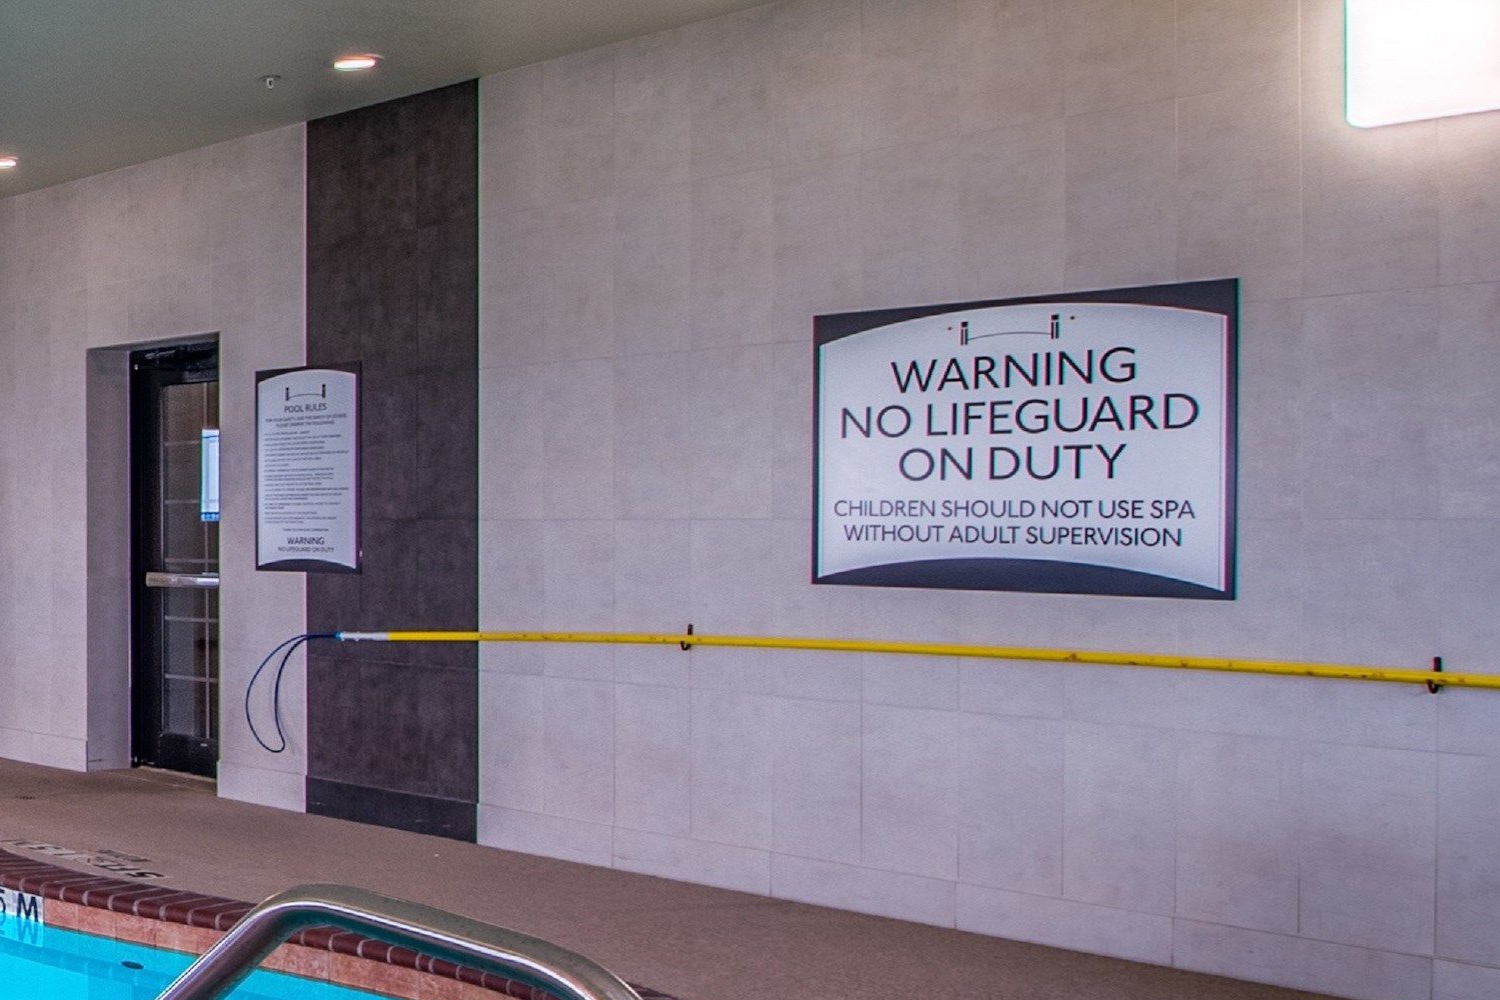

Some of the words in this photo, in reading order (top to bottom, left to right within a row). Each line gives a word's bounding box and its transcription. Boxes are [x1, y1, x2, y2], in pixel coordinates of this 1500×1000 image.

[891, 347, 1137, 394] WARNING
[284, 405, 304, 413] POOL
[305, 402, 328, 412] RULES
[841, 405, 912, 439] NO
[926, 393, 1199, 436] LIFEGUARD
[899, 447, 972, 482] ON
[989, 443, 1127, 480] DUTY
[833, 500, 936, 518] CHILDREN
[941, 499, 1035, 518] SHOULD
[1041, 500, 1093, 519] NOT
[1099, 500, 1143, 519] USE
[1149, 500, 1195, 520] SPA
[287, 536, 326, 546] WARNING
[843, 525, 944, 543] WITHOUT
[949, 526, 1020, 544] ADULT
[1026, 526, 1182, 547] SUPERVISION
